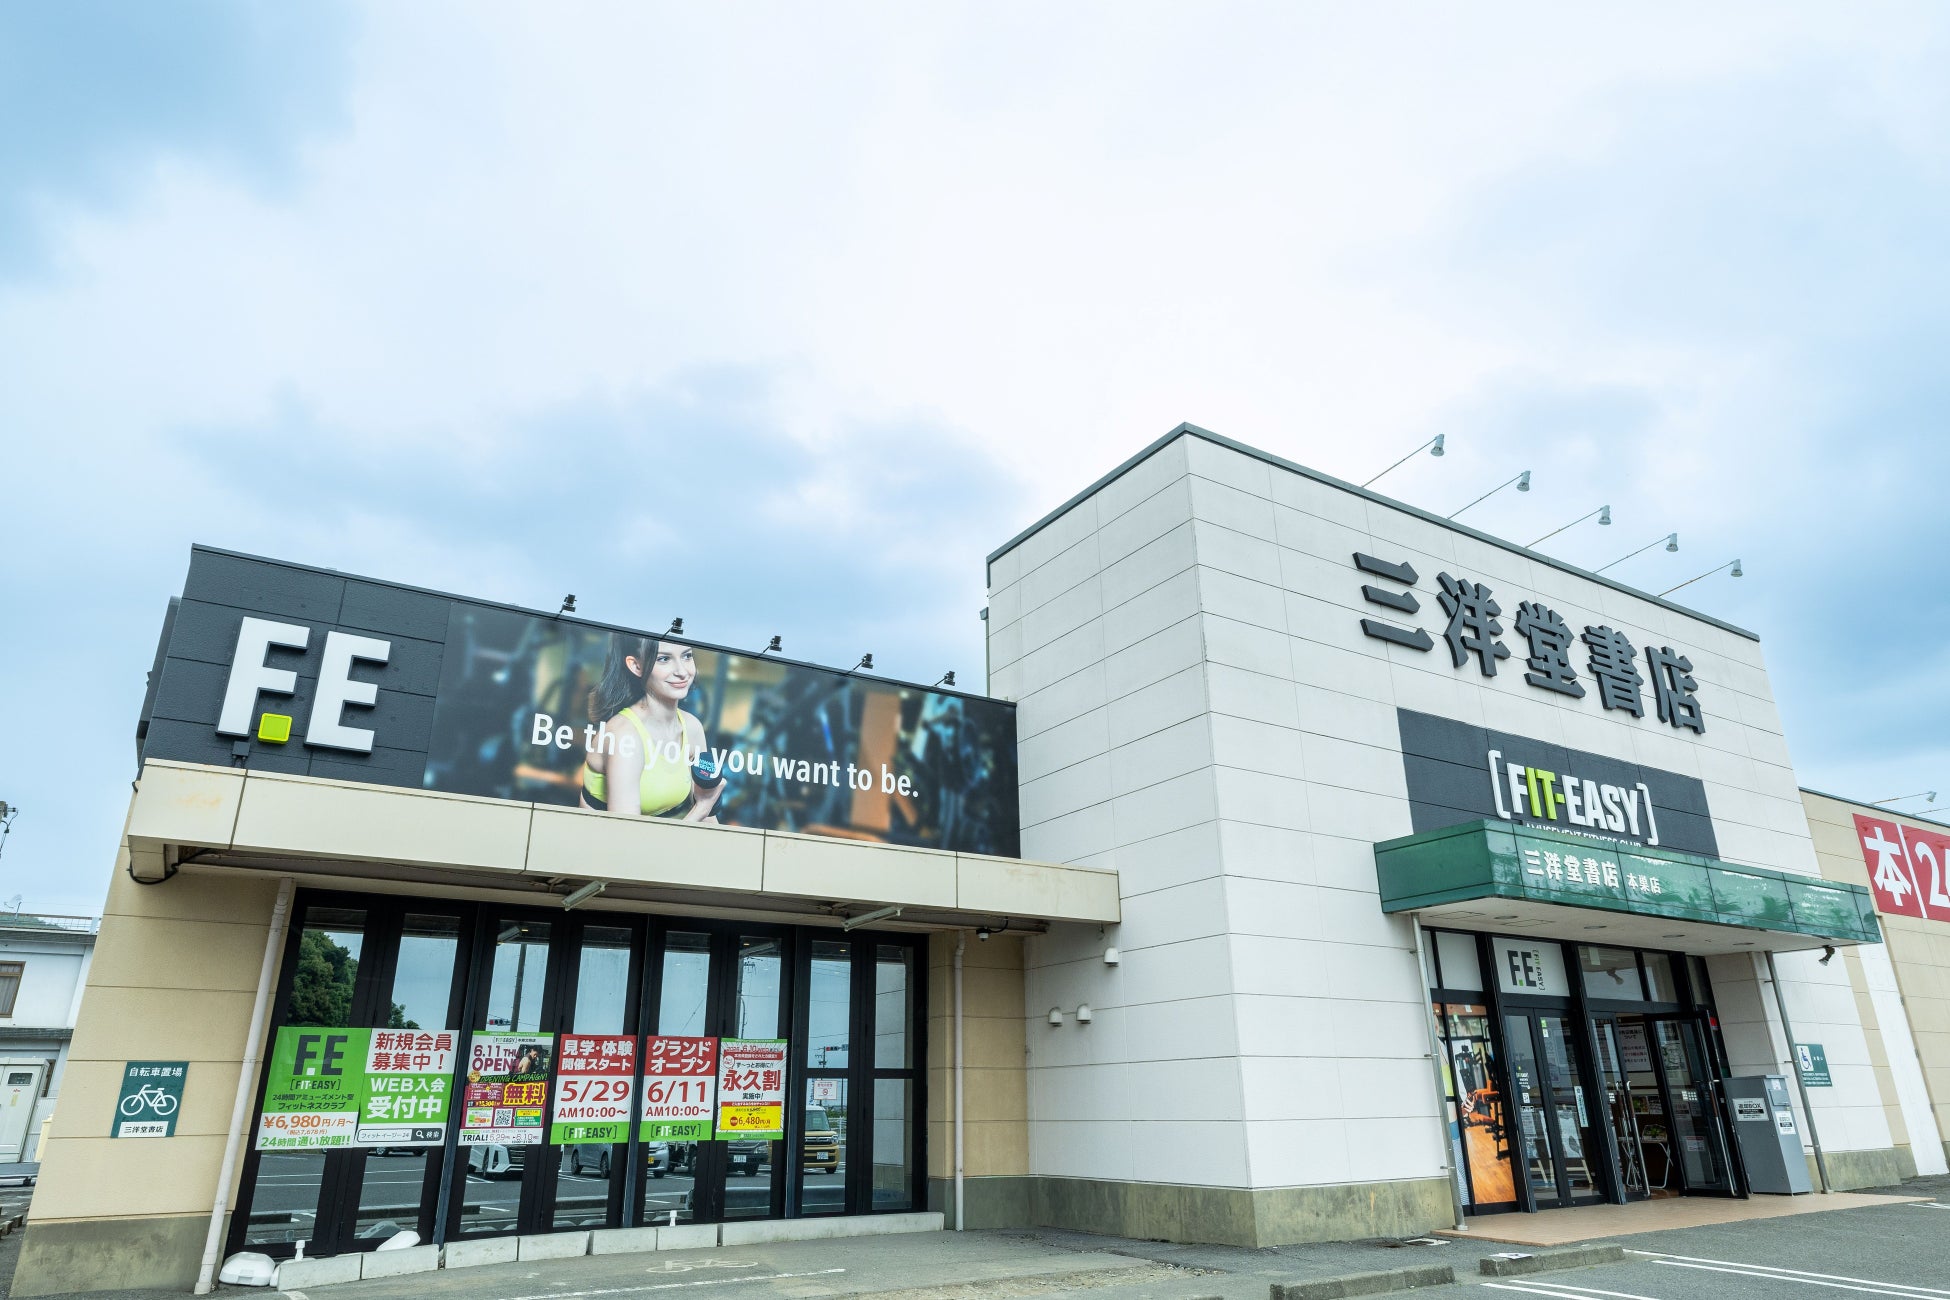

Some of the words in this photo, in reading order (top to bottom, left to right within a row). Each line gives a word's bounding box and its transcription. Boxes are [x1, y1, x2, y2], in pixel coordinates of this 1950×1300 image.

[1352, 552, 1705, 734] 三洋堂書店
[531, 713, 574, 750] Be
[584, 721, 637, 758] the
[644, 738, 700, 770] you
[710, 747, 764, 779] you
[773, 756, 840, 788] want
[848, 763, 874, 791] to
[881, 763, 919, 798] be.
[1524, 850, 1619, 888] 三洋堂書店
[1627, 872, 1661, 894] 本巣店
[1864, 826, 1911, 906] 本
[375, 1032, 452, 1052] 新規会員
[652, 1040, 712, 1056] グランド
[129, 1066, 183, 1077] 自転車置場
[561, 1058, 631, 1071] 開催スタート
[651, 1057, 711, 1073] オープン
[560, 1080, 630, 1102] 5/29
[723, 1069, 781, 1091] 永久割
[503, 1083, 546, 1105] 無料
[647, 1080, 706, 1104] 6/11
[278, 1102, 346, 1110] フィットネスクラブ
[367, 1095, 442, 1119] 受付中
[124, 1125, 163, 1133] 三洋堂書店
